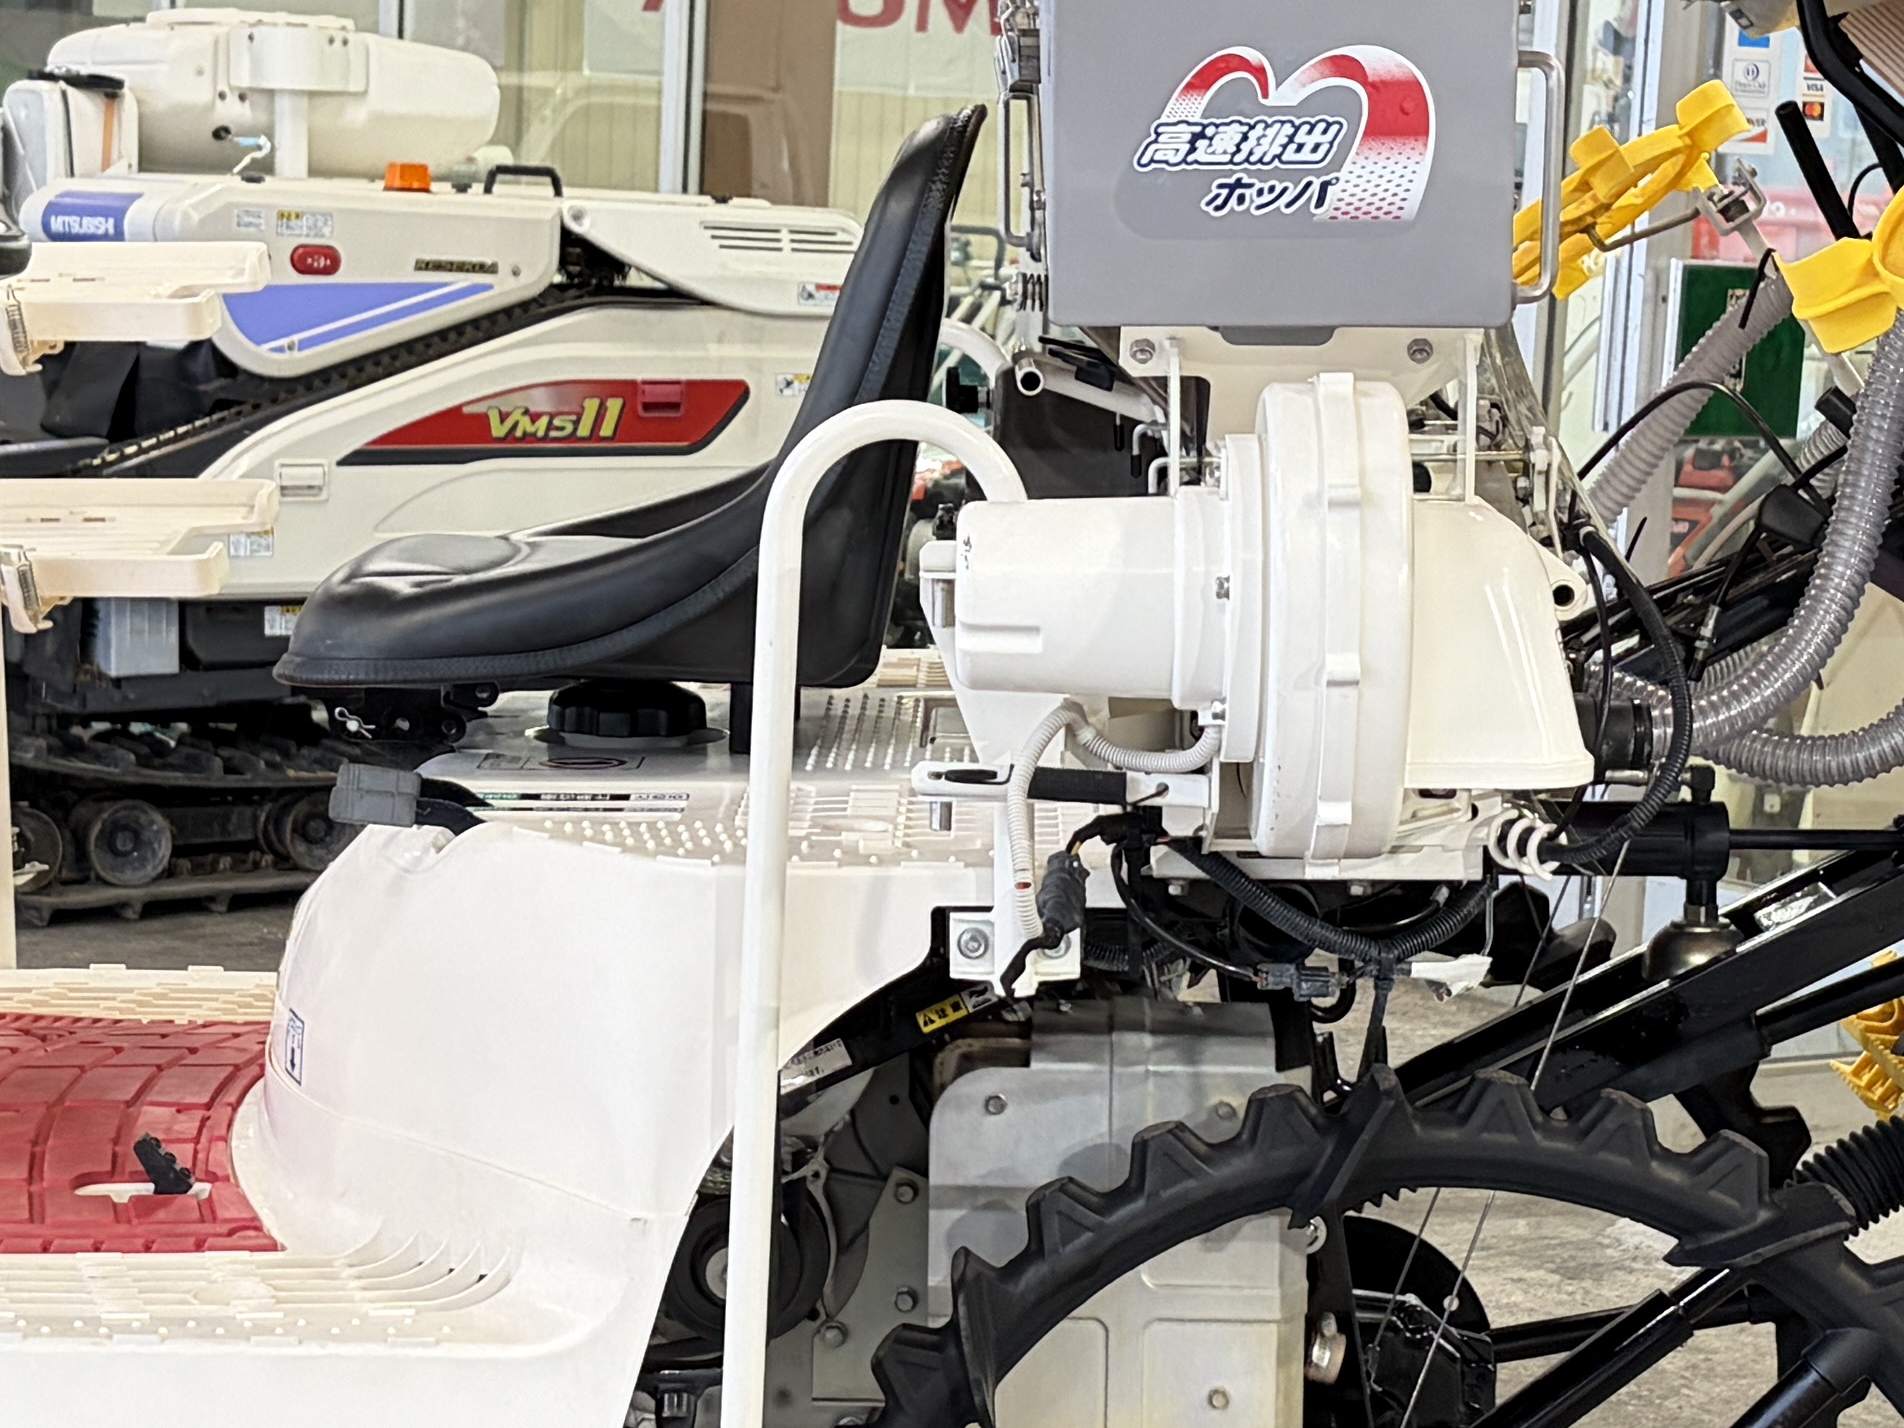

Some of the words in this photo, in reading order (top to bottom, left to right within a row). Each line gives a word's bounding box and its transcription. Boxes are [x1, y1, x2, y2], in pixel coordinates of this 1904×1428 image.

[1136, 117, 1346, 169] 高速排出
[1203, 175, 1340, 215] ホッパ
